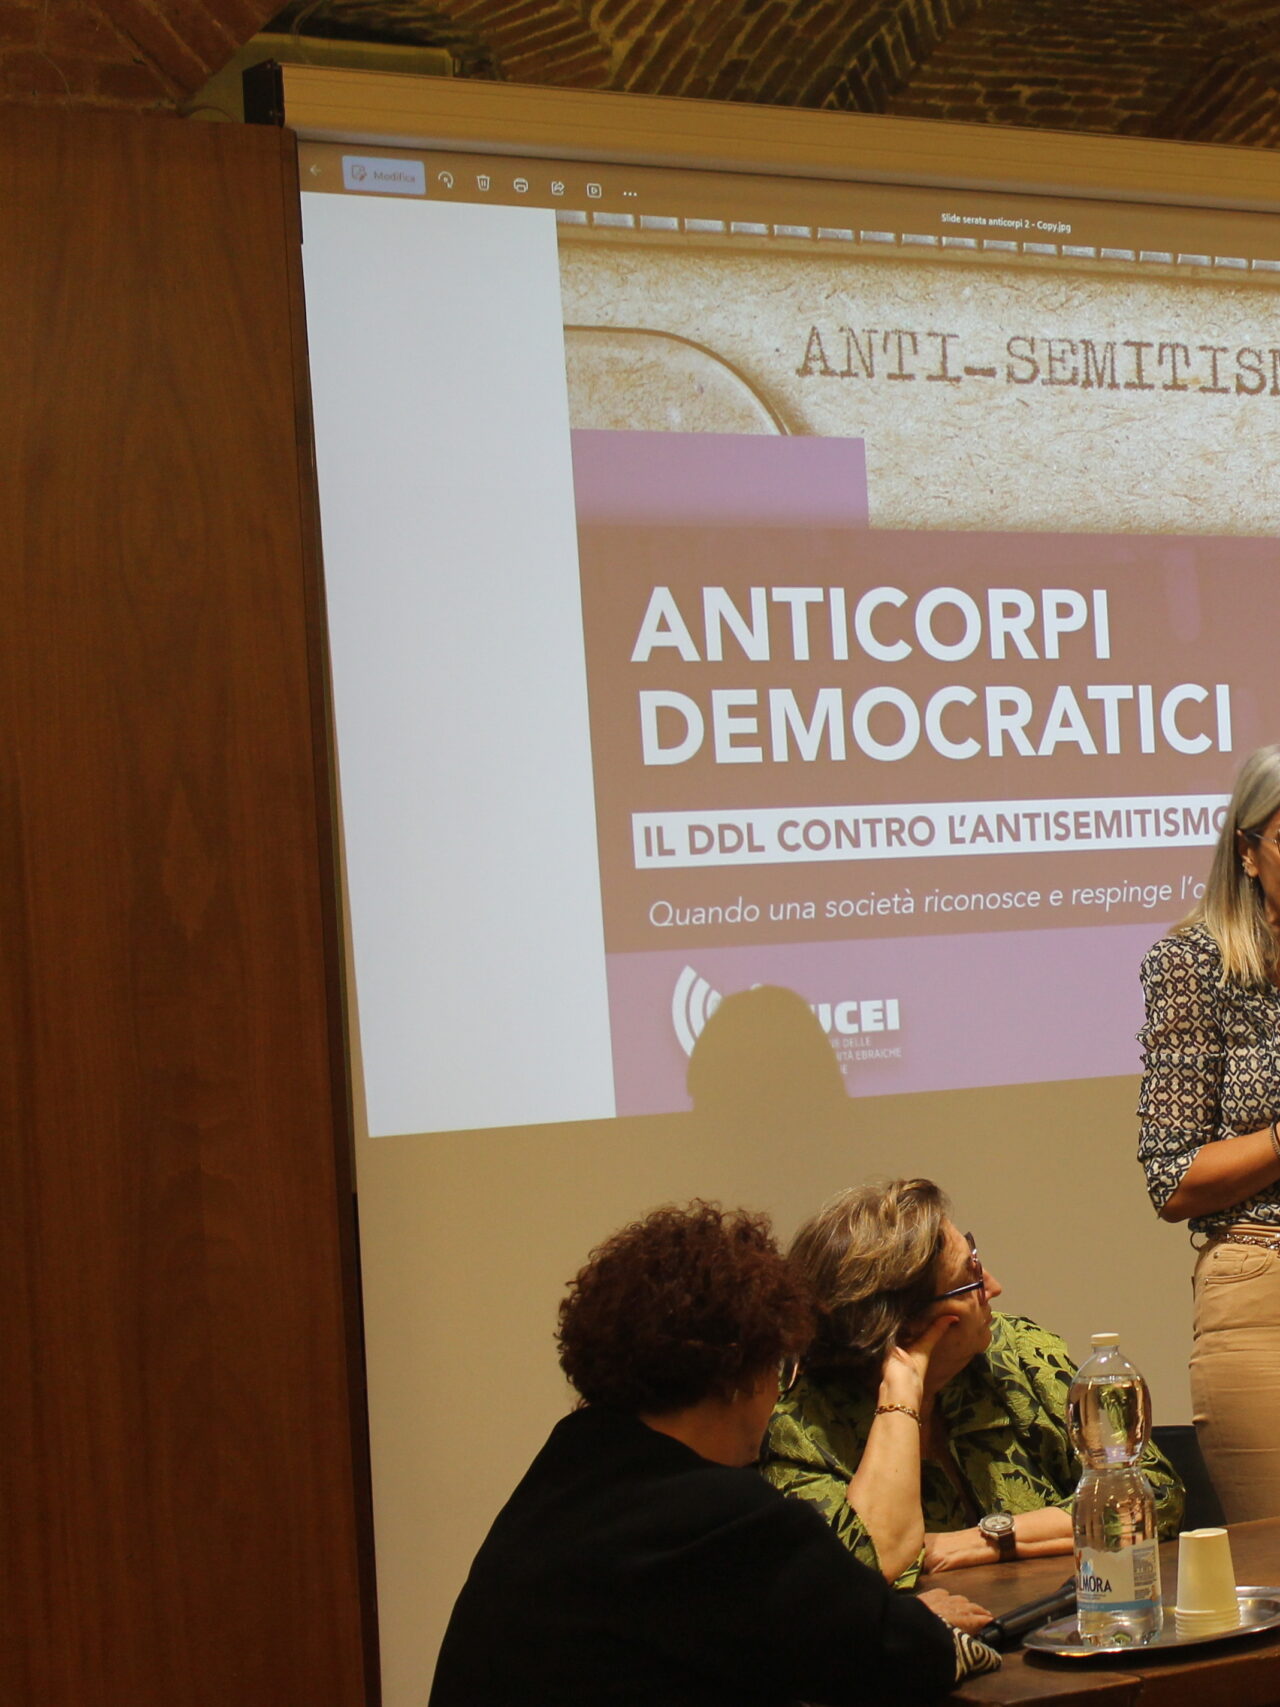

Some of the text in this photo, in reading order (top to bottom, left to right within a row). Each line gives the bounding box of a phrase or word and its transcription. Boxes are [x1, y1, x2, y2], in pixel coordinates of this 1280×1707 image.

[941, 213, 961, 223] Slide
[962, 216, 986, 225] serata
[988, 218, 1023, 229] anticorpi
[1024, 219, 1030, 228] 2
[1037, 220, 1071, 233] Copy.jpg
[630, 586, 1110, 662] ANTICORPI
[639, 683, 1232, 765] DEMOCRATICI
[644, 825, 676, 857] IL
[688, 822, 765, 855] DDL
[777, 815, 936, 853] CONTRO
[649, 896, 760, 927] Quando
[769, 900, 816, 921] una
[825, 888, 915, 918] società
[924, 889, 1041, 913] riconosce
[1049, 889, 1064, 906] e
[1072, 880, 1173, 912] respinge
[842, 1036, 871, 1048] DELLE
[855, 1047, 902, 1061] EBRAICHE
